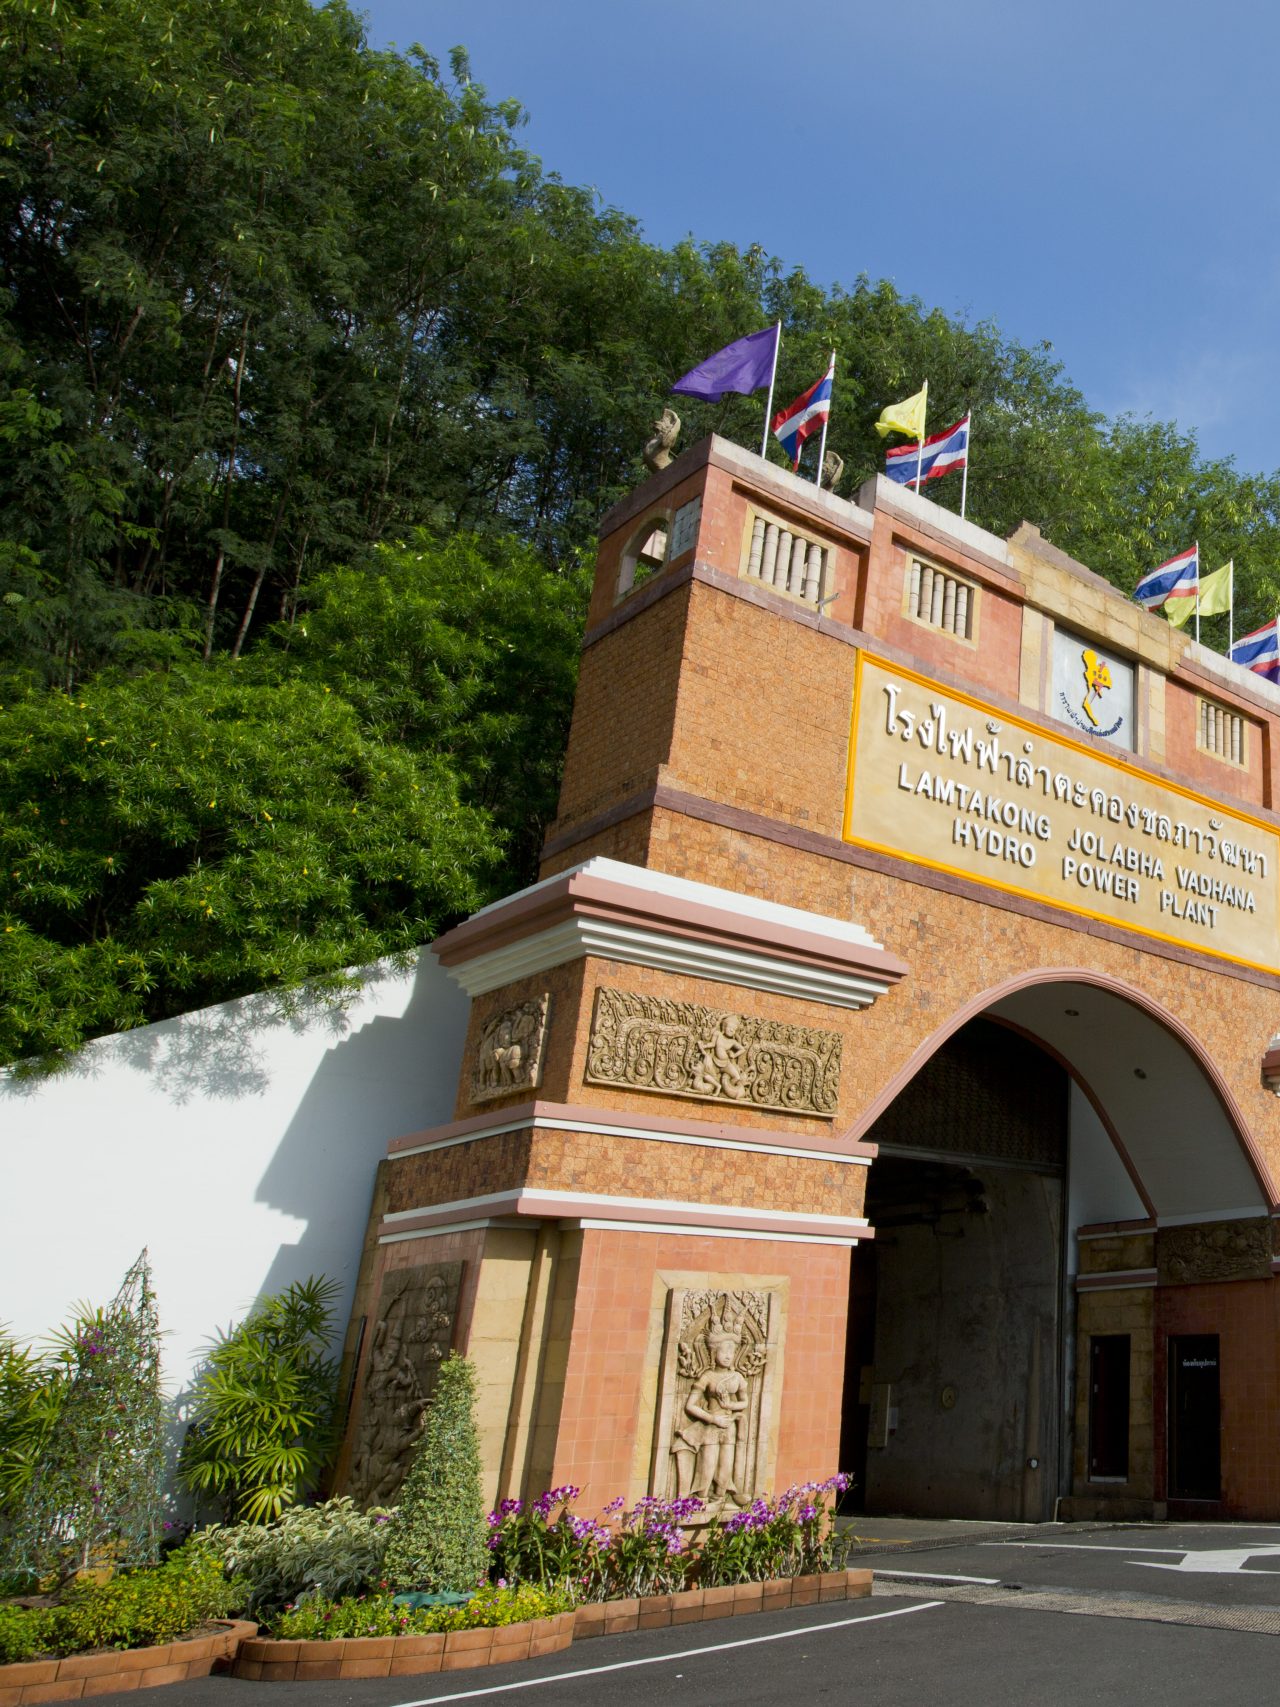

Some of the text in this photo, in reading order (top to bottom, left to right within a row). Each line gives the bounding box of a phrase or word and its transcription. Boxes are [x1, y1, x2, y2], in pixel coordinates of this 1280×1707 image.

[884, 683, 1268, 878] โรงไฟฟ้าลำตะคองชลภาวัฒนา
[898, 762, 1257, 913] LAMTAKONG JOLABHA VADHANA
[953, 817, 1221, 928] HYDRO POWER PLANT
